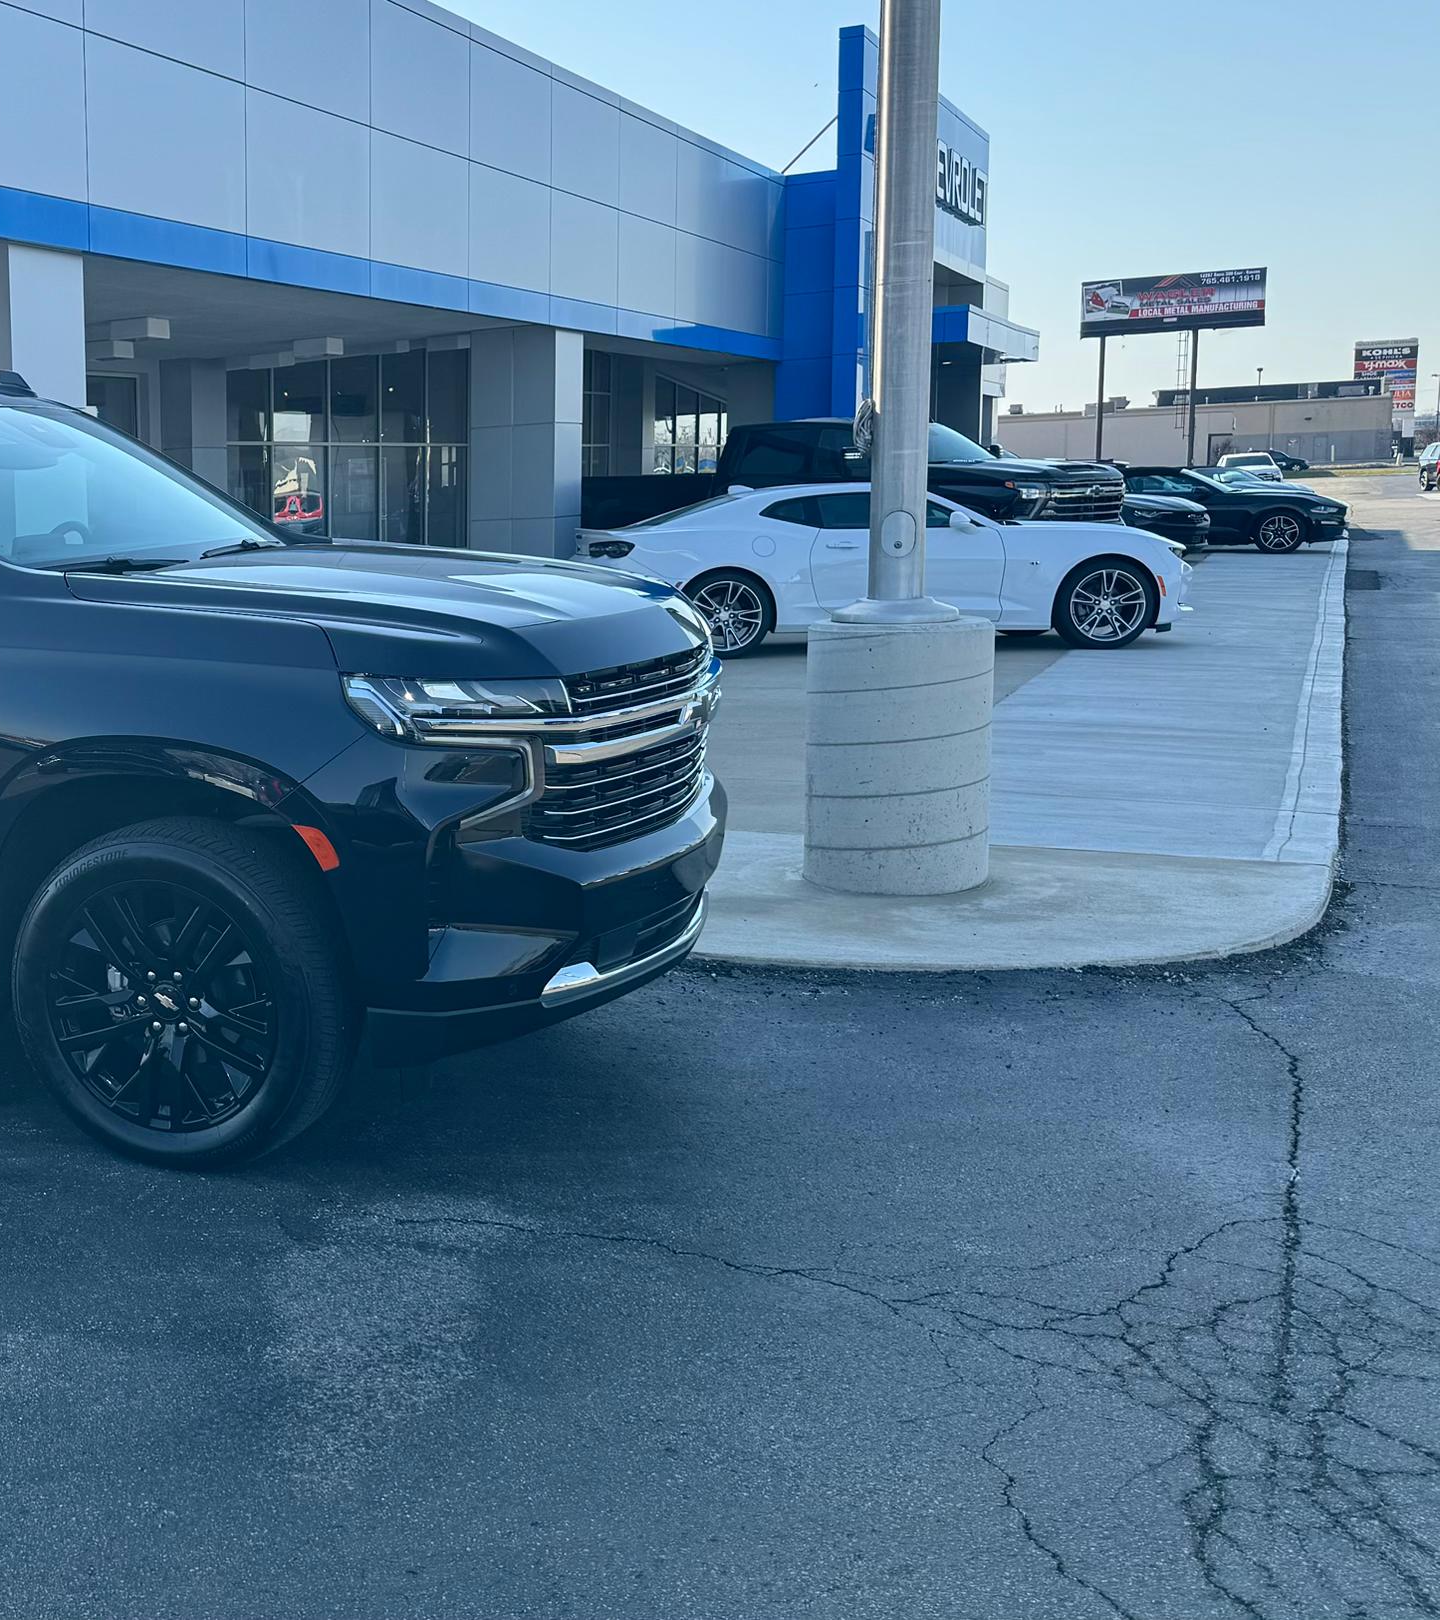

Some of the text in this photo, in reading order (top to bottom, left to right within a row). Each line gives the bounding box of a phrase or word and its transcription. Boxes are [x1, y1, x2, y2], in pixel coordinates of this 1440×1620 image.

[1140, 296, 1212, 307] METAL SALES
[1138, 301, 1258, 317] LOCAL METAL MANUFACTURING
[1362, 347, 1411, 357] KOHL'S
